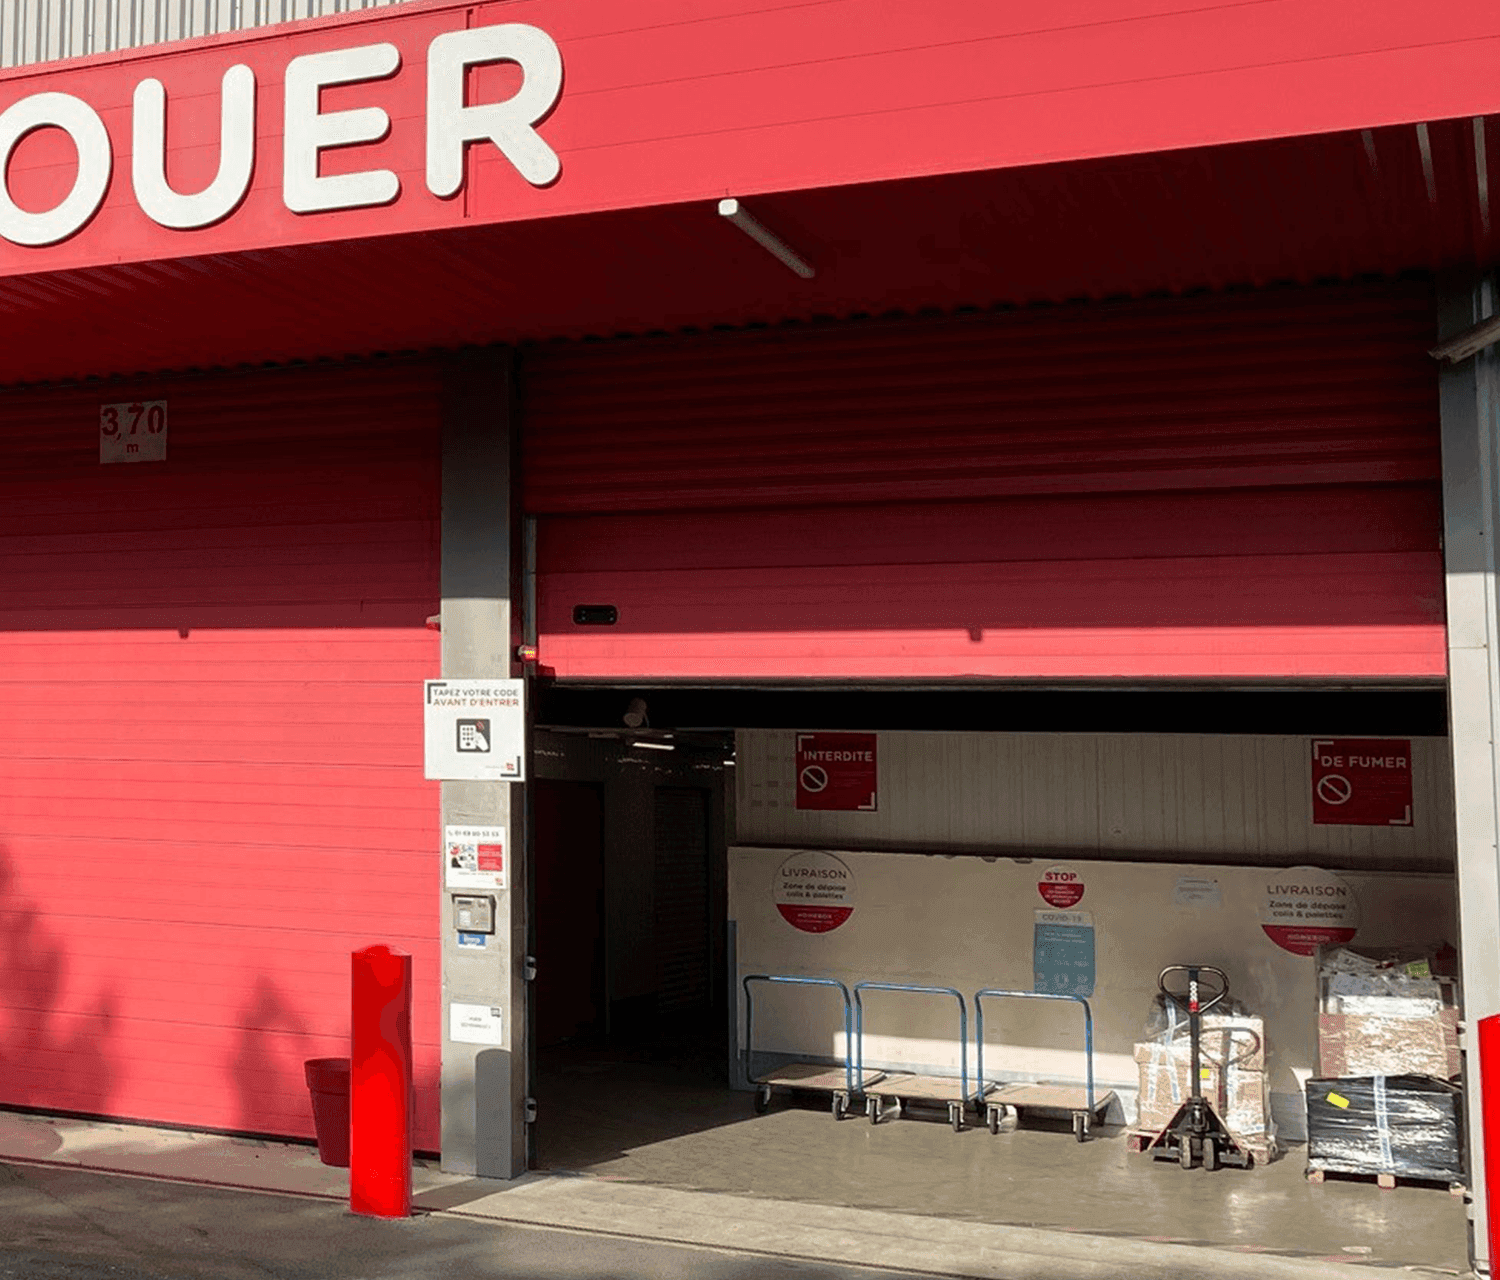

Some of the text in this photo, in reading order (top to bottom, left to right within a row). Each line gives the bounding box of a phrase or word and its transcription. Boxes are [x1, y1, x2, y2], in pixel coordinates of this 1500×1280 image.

[101, 405, 165, 441] 3,70
[126, 443, 139, 453] m
[433, 688, 519, 697] TAPEZ VOTRE CODE
[433, 698, 519, 706] AVANT D'ENTRER
[803, 750, 874, 762] INTERDITE
[1320, 755, 1407, 769] DE FUMER
[781, 867, 847, 879] LIVRAISON
[1044, 871, 1078, 882] STOP
[782, 881, 803, 890] Zone
[805, 882, 816, 890] de
[1266, 884, 1347, 897] LIVRAISON
[1269, 900, 1294, 909] Zone
[1295, 901, 1309, 909] de
